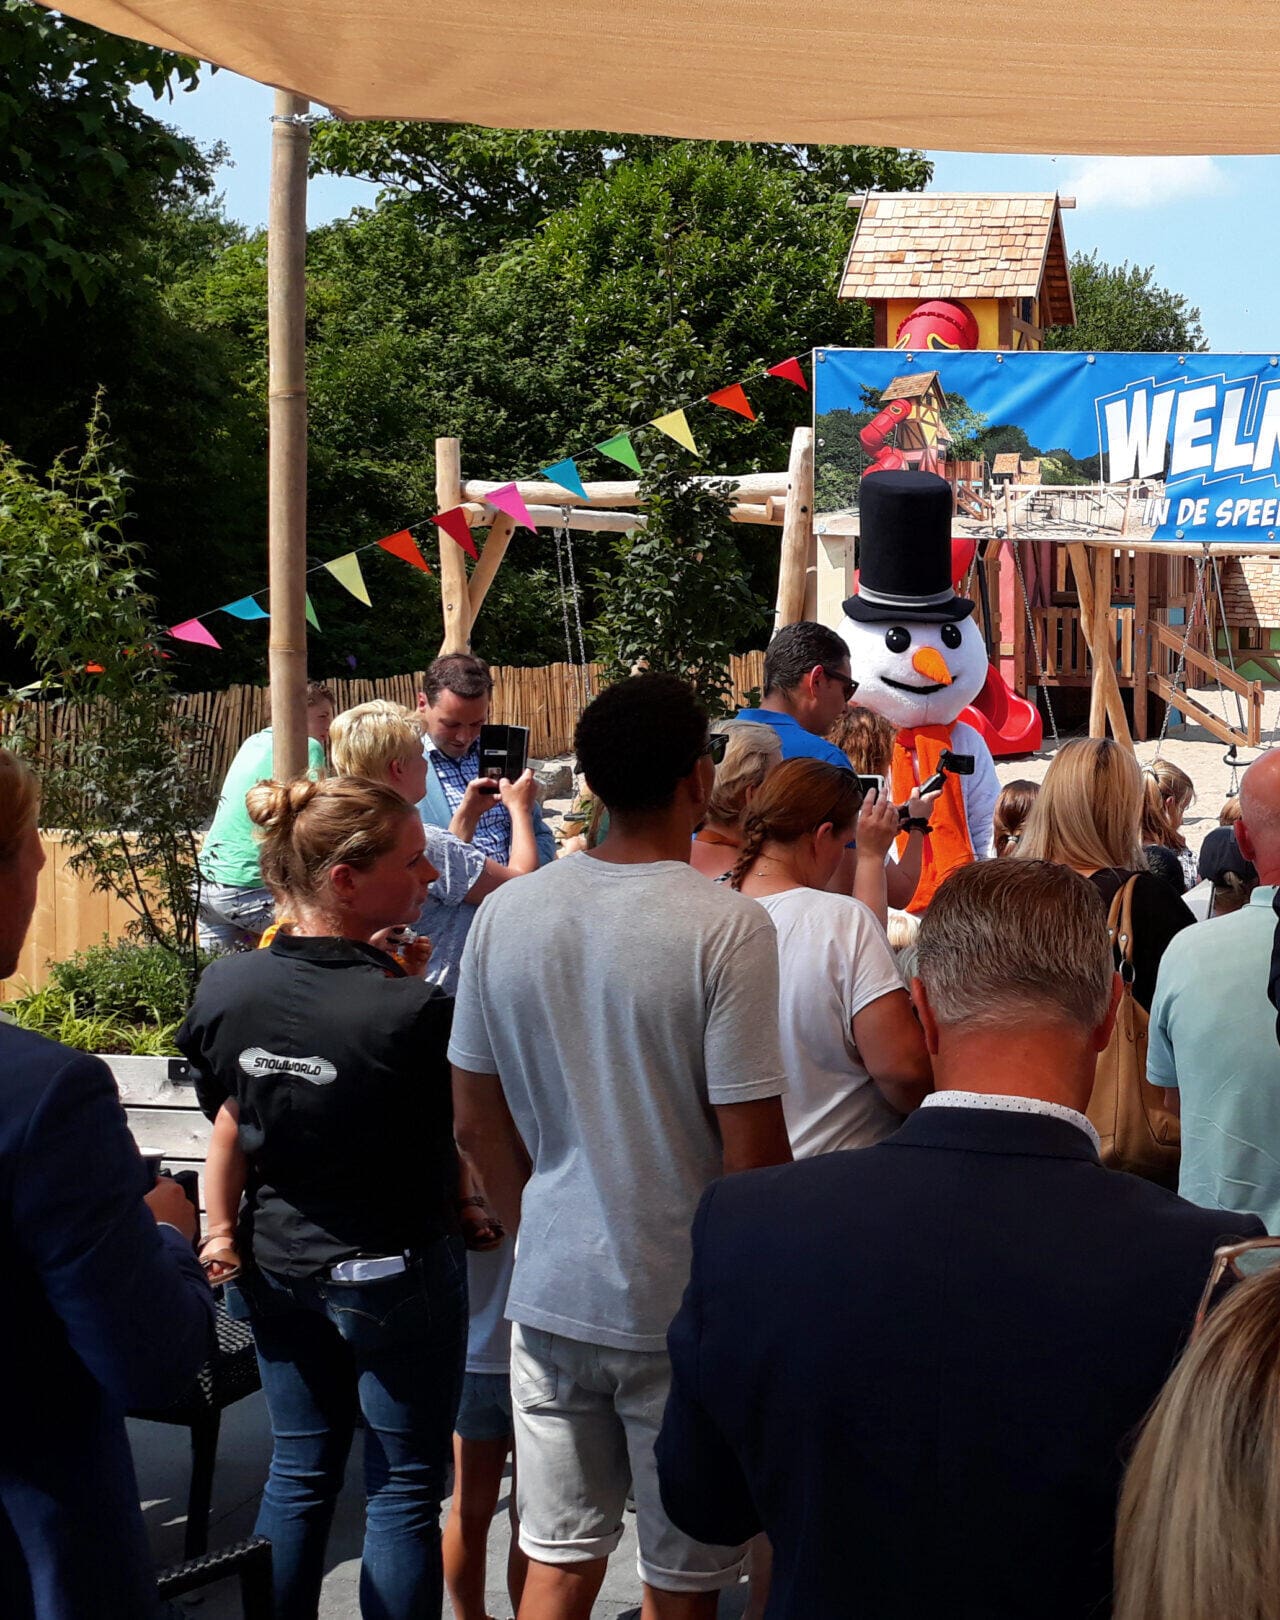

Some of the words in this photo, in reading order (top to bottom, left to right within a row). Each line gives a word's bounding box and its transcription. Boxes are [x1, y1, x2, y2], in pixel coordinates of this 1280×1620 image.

[1142, 498, 1171, 527] IN
[1176, 498, 1210, 526] DE
[253, 1057, 322, 1076] SNOWWORLD
